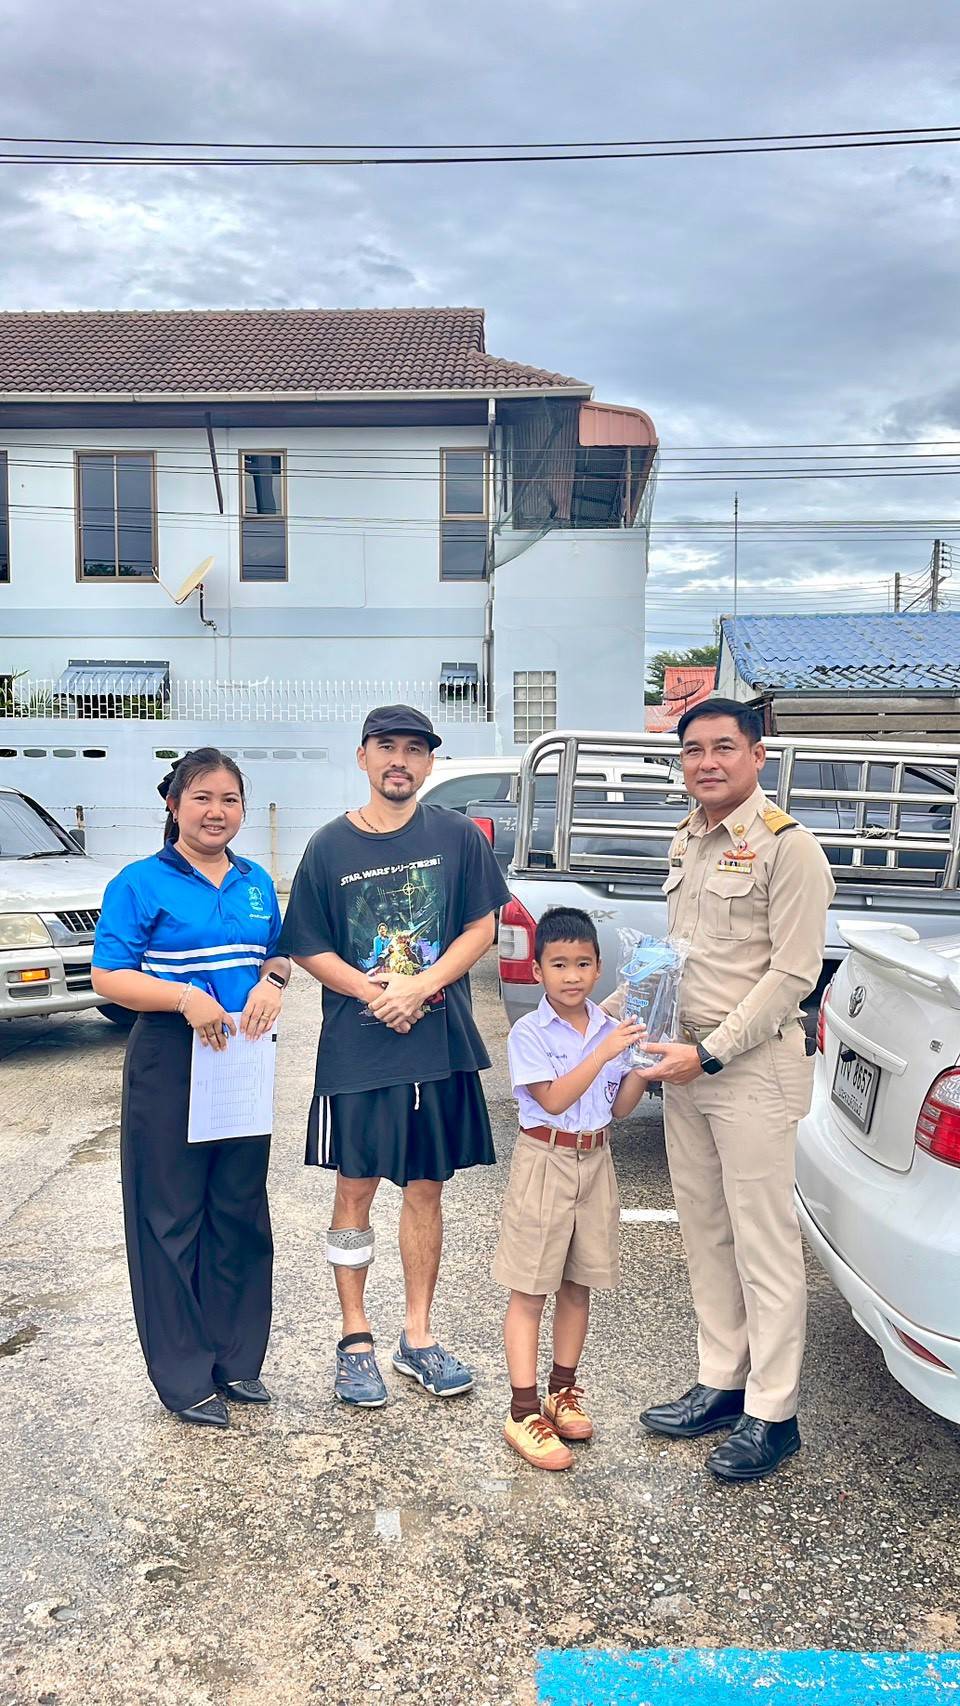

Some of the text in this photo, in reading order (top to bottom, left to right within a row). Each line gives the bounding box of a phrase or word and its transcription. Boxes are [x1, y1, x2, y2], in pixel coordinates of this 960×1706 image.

[340, 873, 362, 886] STAR
[362, 866, 390, 879] WARS
[853, 1063, 872, 1097] 8657
